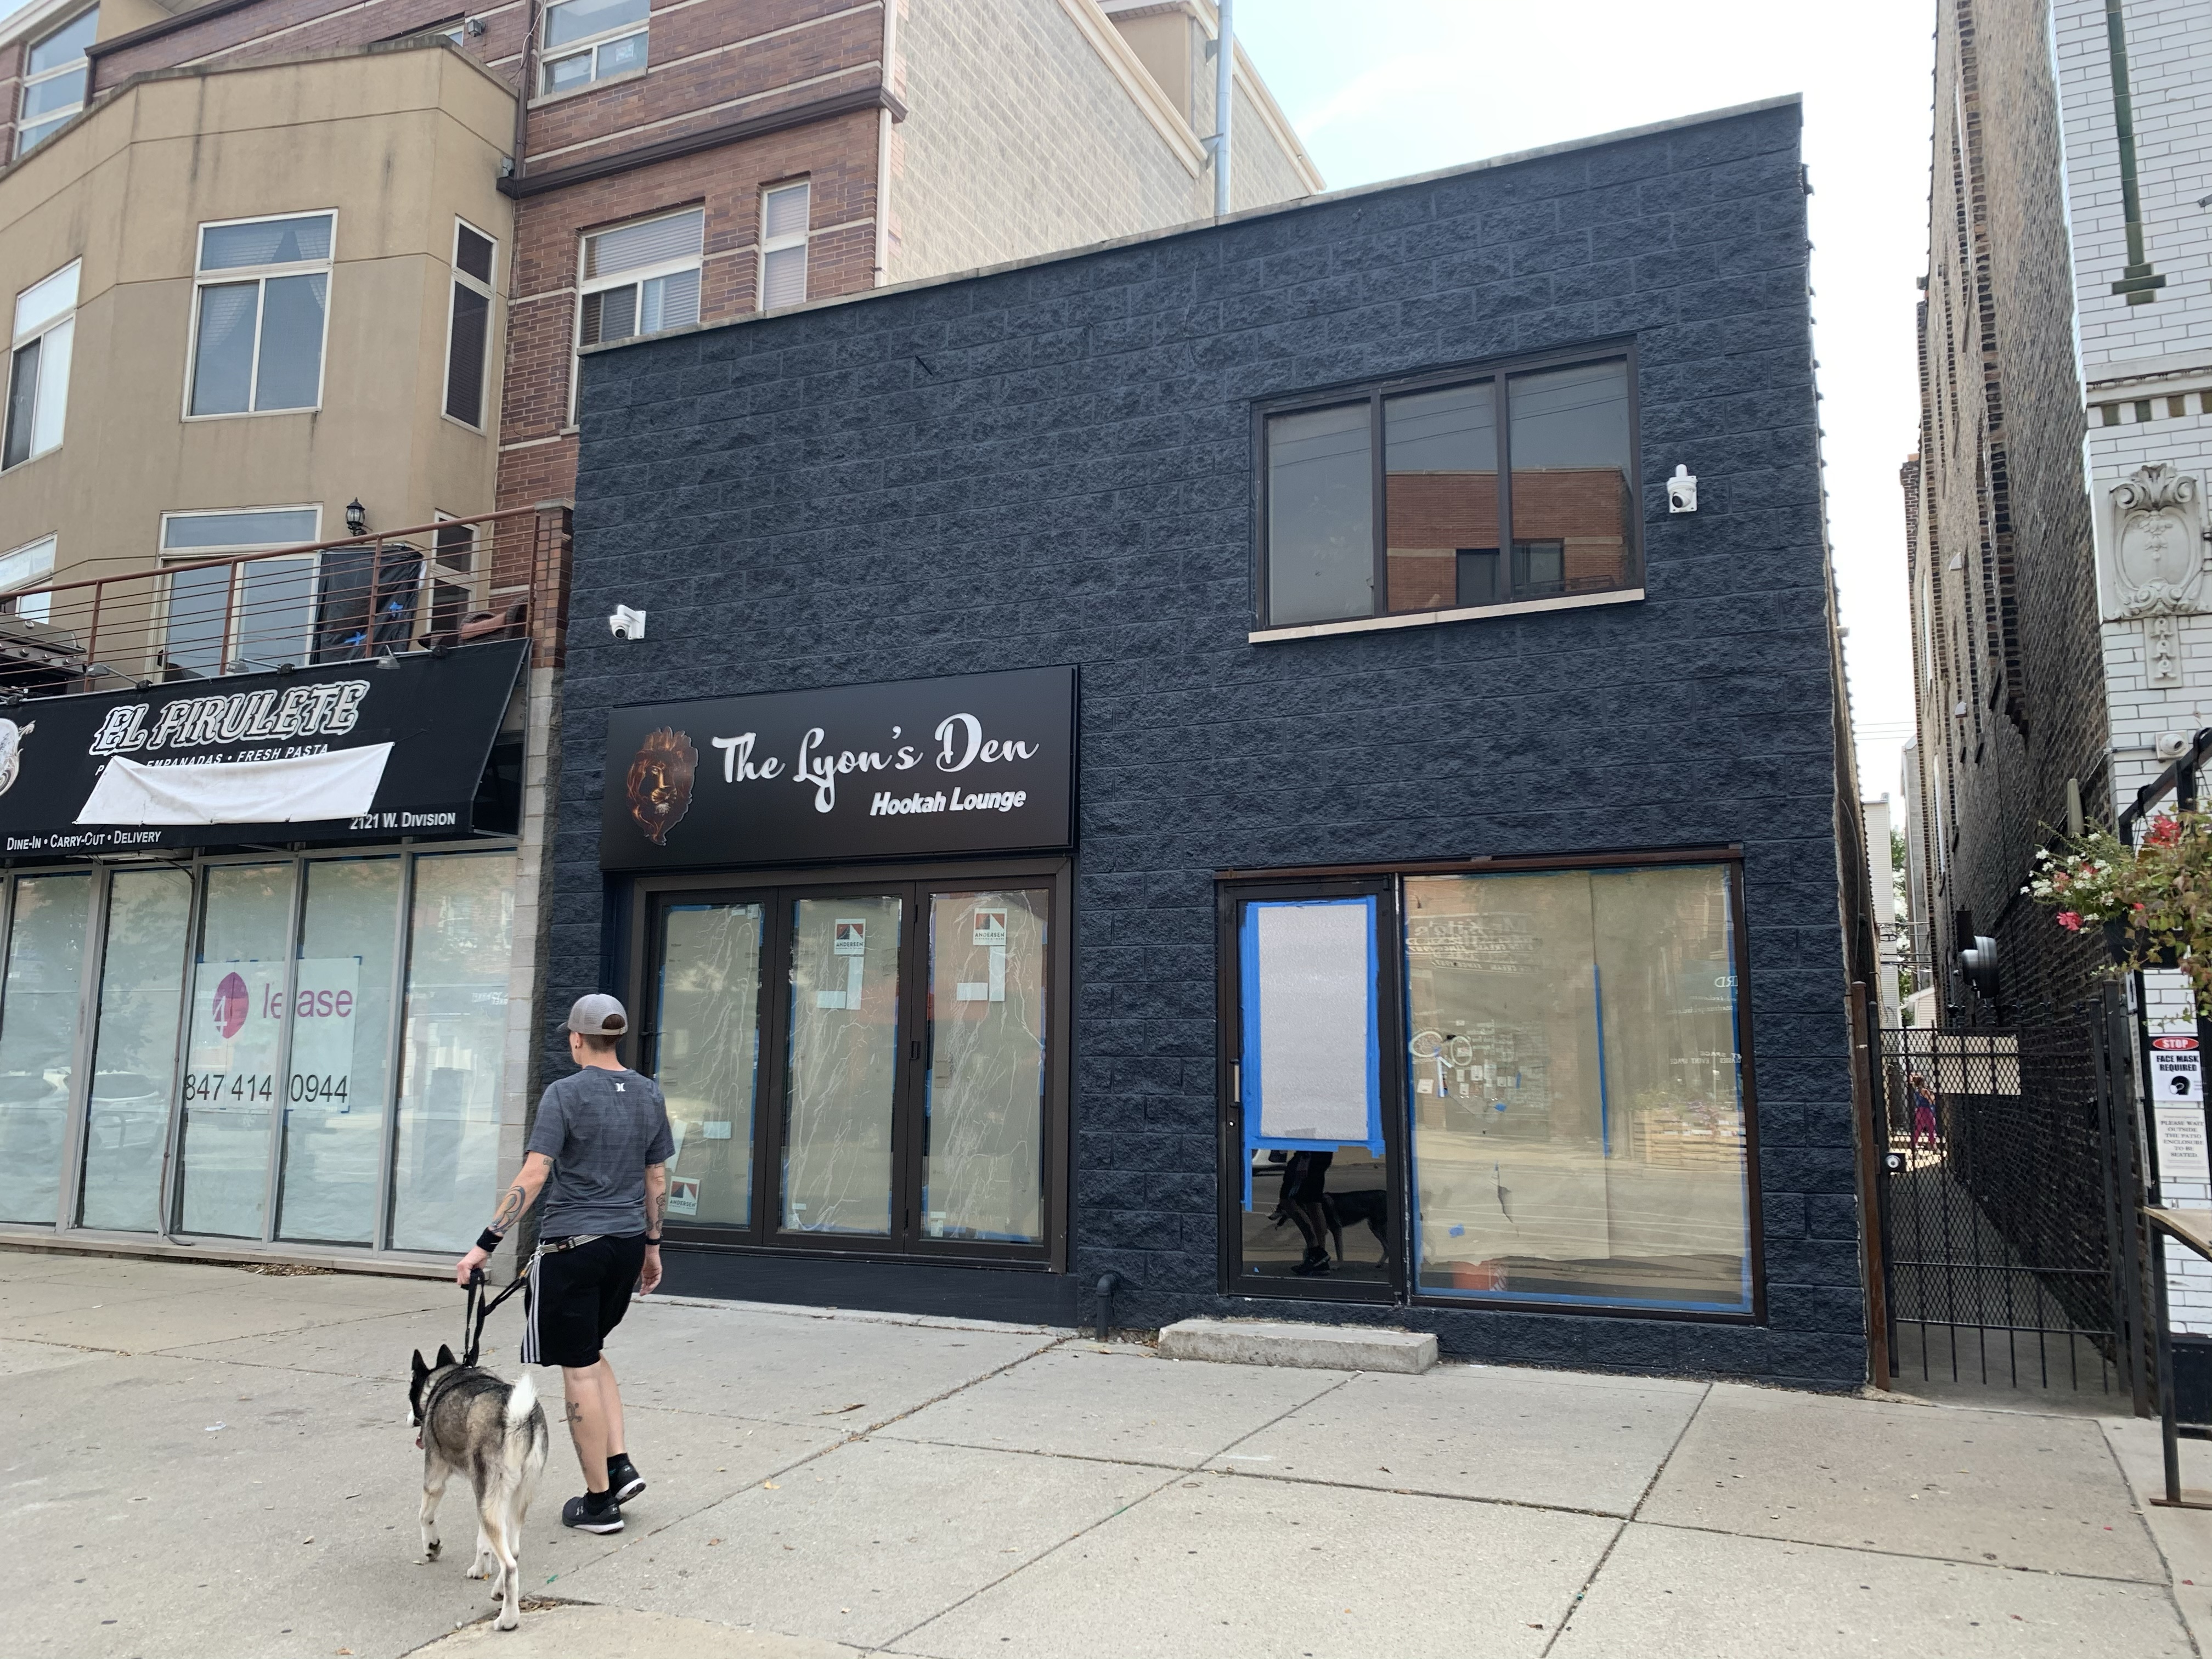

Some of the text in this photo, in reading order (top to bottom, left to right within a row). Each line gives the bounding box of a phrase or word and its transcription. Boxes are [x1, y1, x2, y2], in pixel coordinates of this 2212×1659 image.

[89, 680, 370, 756] EL FIRULETE
[236, 748, 282, 762] FRESH
[285, 744, 328, 758] PASTA
[712, 713, 1040, 813] The Lyon's Den
[870, 787, 1026, 816] Hookah Lounge
[349, 812, 456, 830] 2121 W. DIVISION
[7, 830, 162, 850] DINE-IN CARRY-OUT DELIVERY
[262, 983, 353, 1019] lease
[2162, 1040, 2188, 1049] STOP
[2159, 1064, 2197, 1072] REQUIRED
[185, 1074, 348, 1103] 847 414 0944
